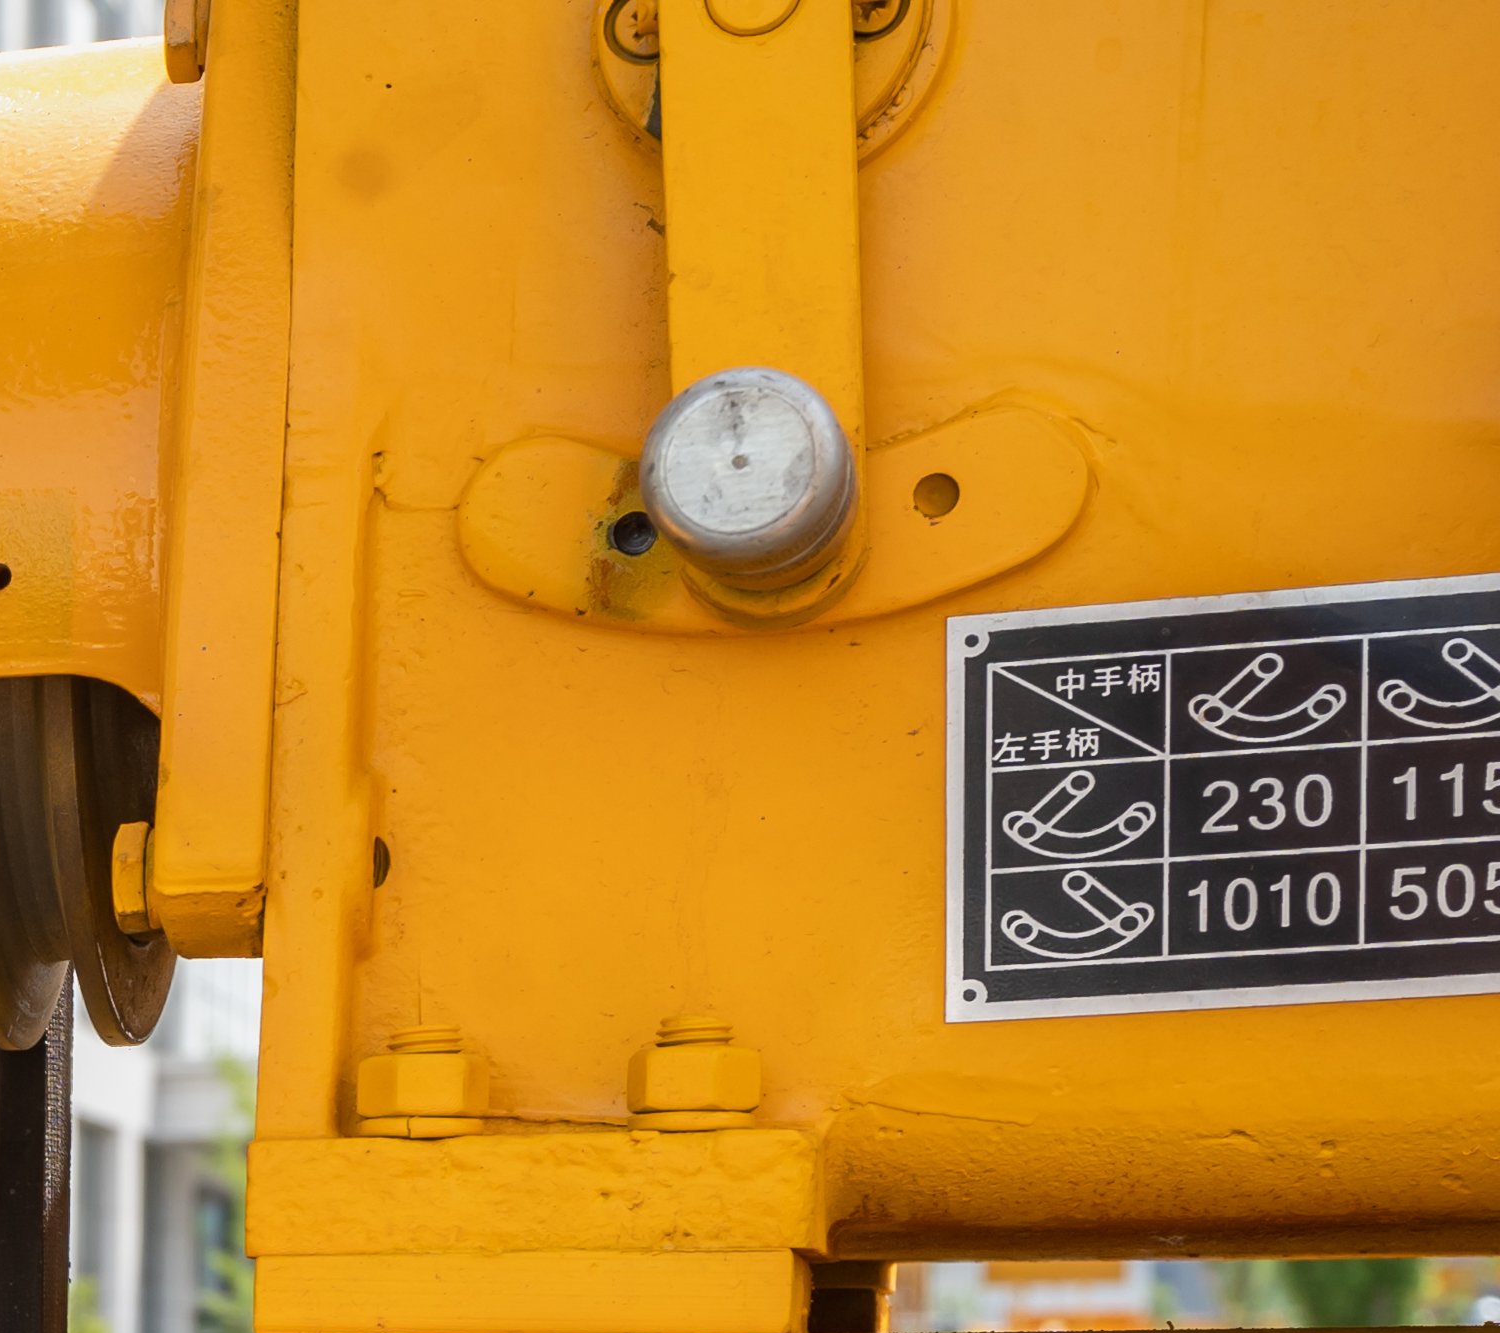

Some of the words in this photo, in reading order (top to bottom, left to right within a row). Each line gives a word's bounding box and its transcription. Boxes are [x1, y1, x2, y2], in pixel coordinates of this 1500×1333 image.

[1056, 664, 1161, 701] 中手柄
[993, 726, 1101, 762] 左手柄
[1201, 773, 1333, 834] 230
[1187, 872, 1342, 933] 1010
